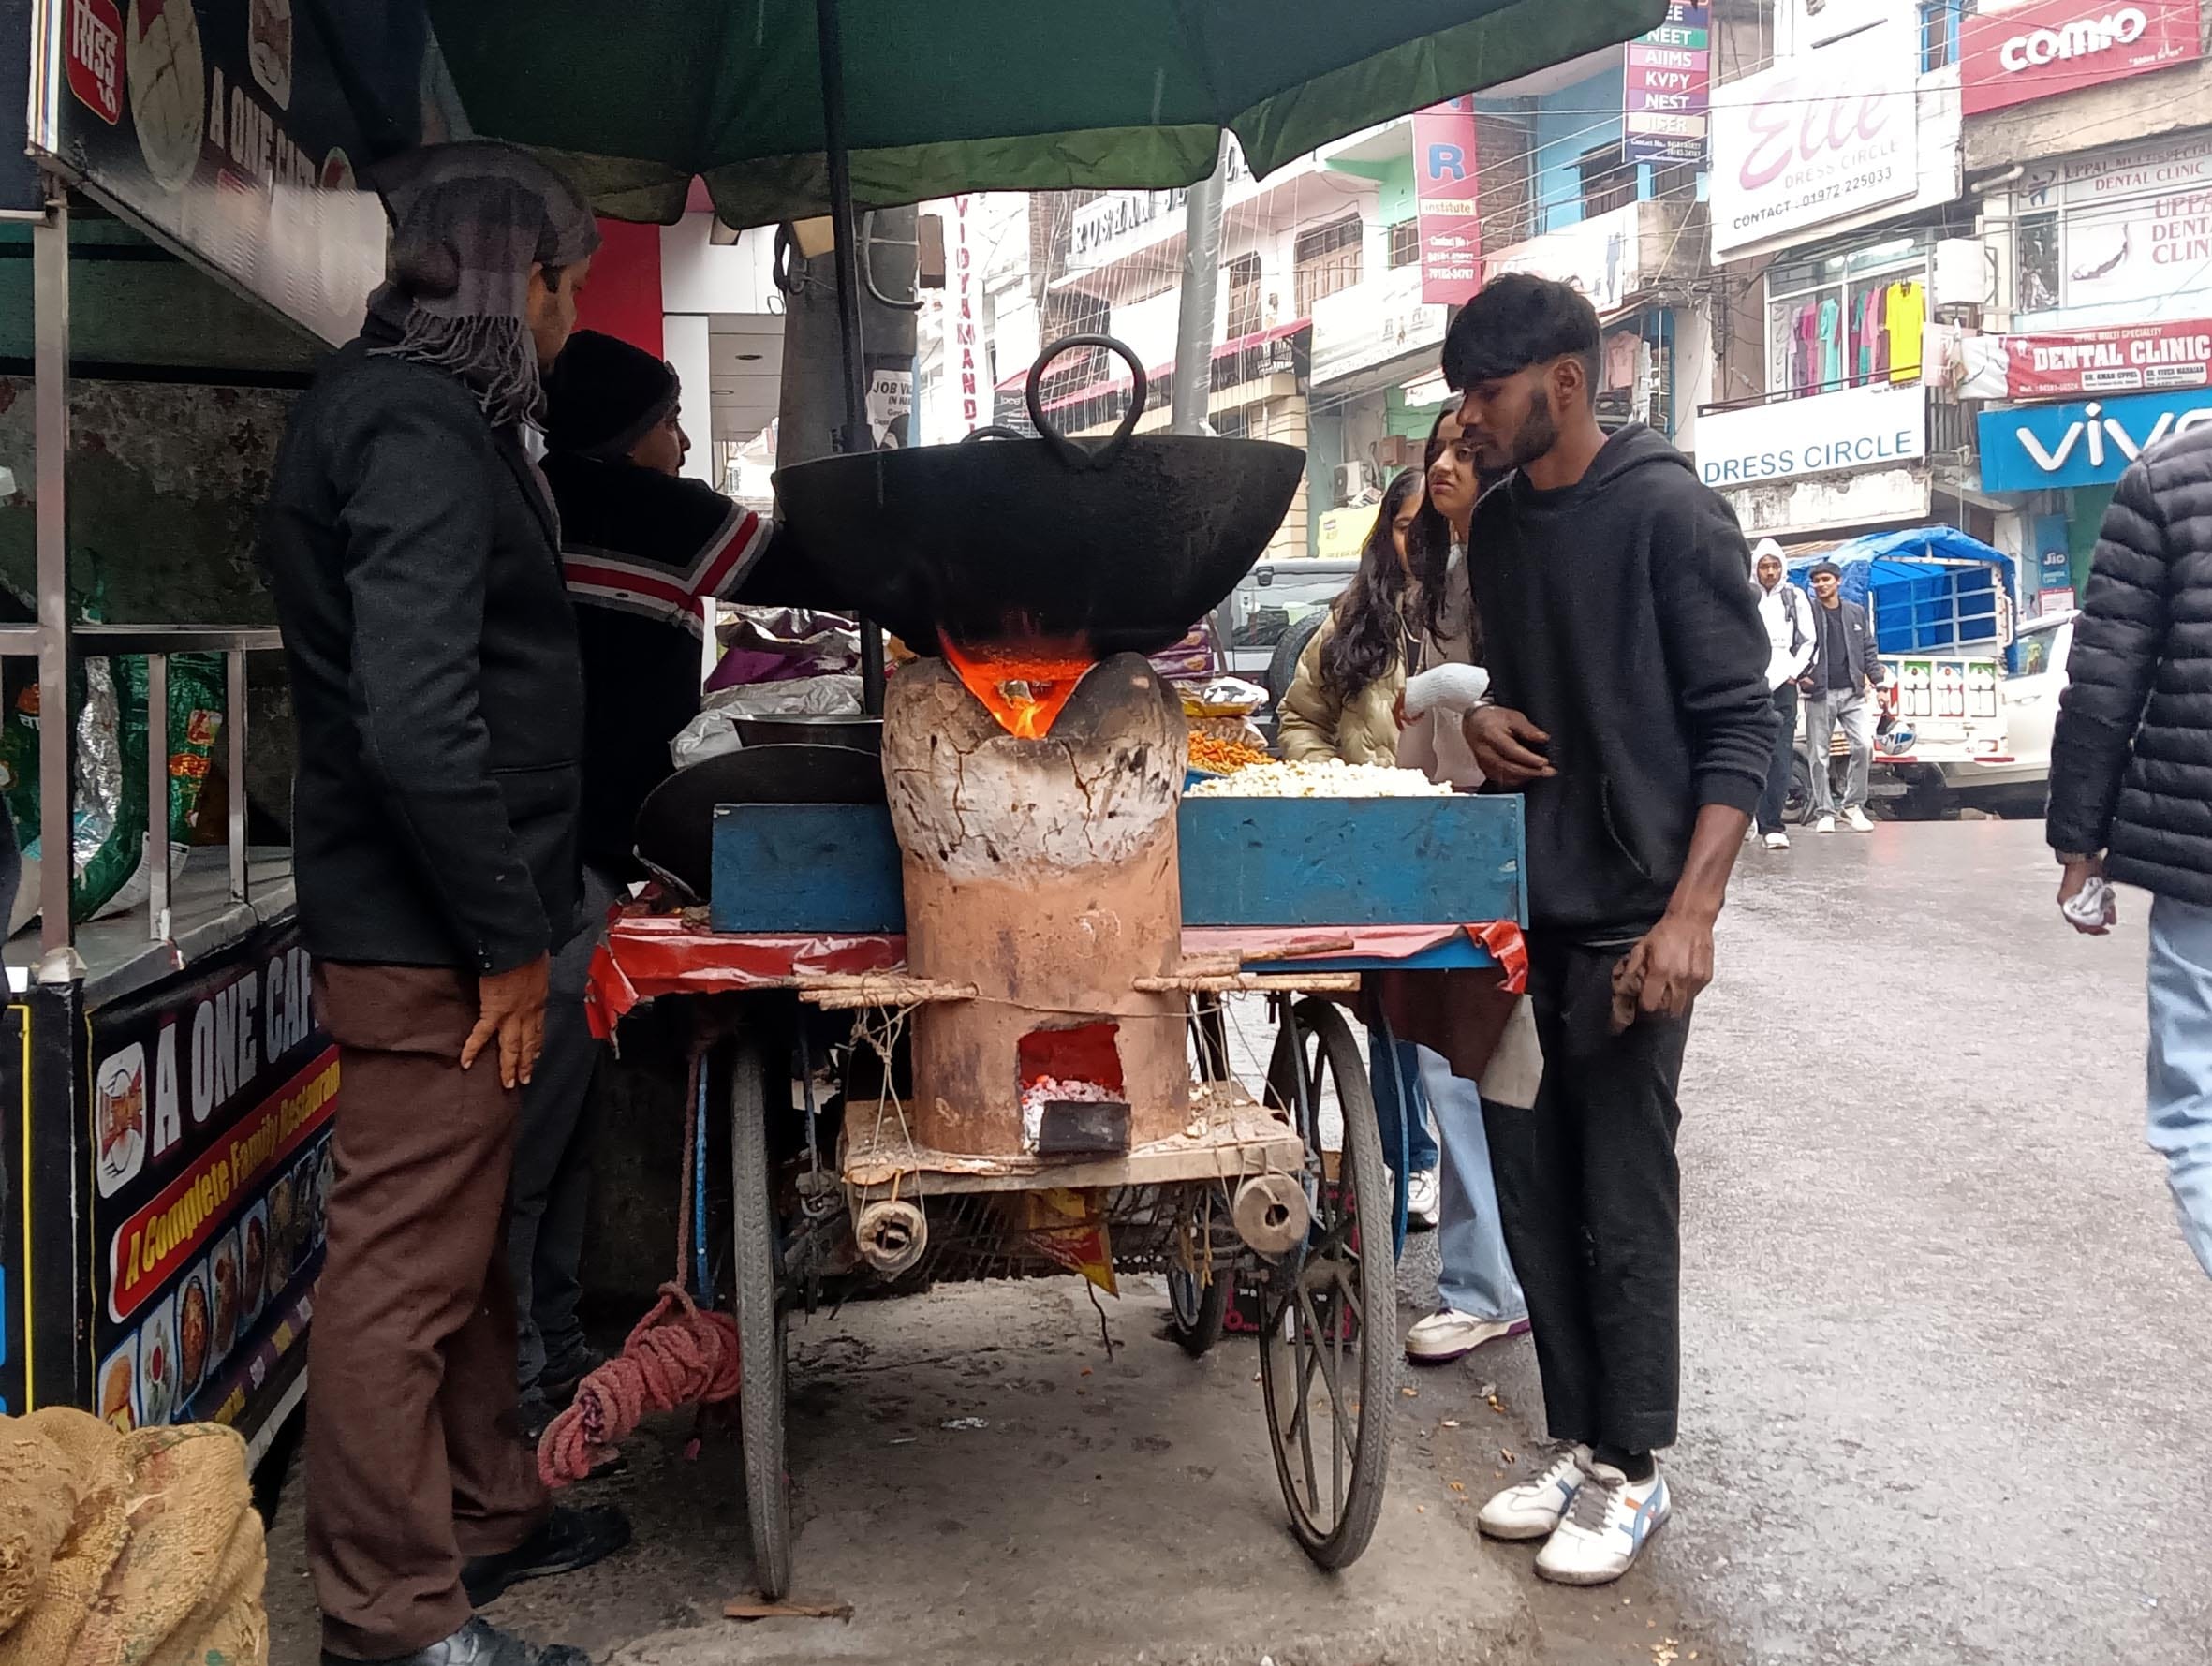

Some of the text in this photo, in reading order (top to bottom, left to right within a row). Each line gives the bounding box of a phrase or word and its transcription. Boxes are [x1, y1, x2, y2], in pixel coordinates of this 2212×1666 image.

[1647, 27, 1692, 45] NEET
[1644, 71, 1691, 90] KVPY
[210, 66, 225, 150] A
[1644, 93, 1690, 111] NEST
[1428, 143, 1467, 181] R
[2094, 161, 2205, 192] DENTAL CLINIC
[1424, 199, 1471, 214] institute
[1733, 199, 1792, 230] CONTACT
[2152, 216, 2212, 242] DENT
[2032, 334, 2212, 372] DENTAL CLINIC
[873, 381, 898, 394] JOB
[888, 395, 898, 405] IN
[1703, 430, 1913, 483] DRESS CIRCLE
[2042, 551, 2067, 567] Jio
[153, 946, 319, 1157] A ONE CAF
[124, 1231, 140, 1291] A
[142, 1157, 230, 1272] Complete
